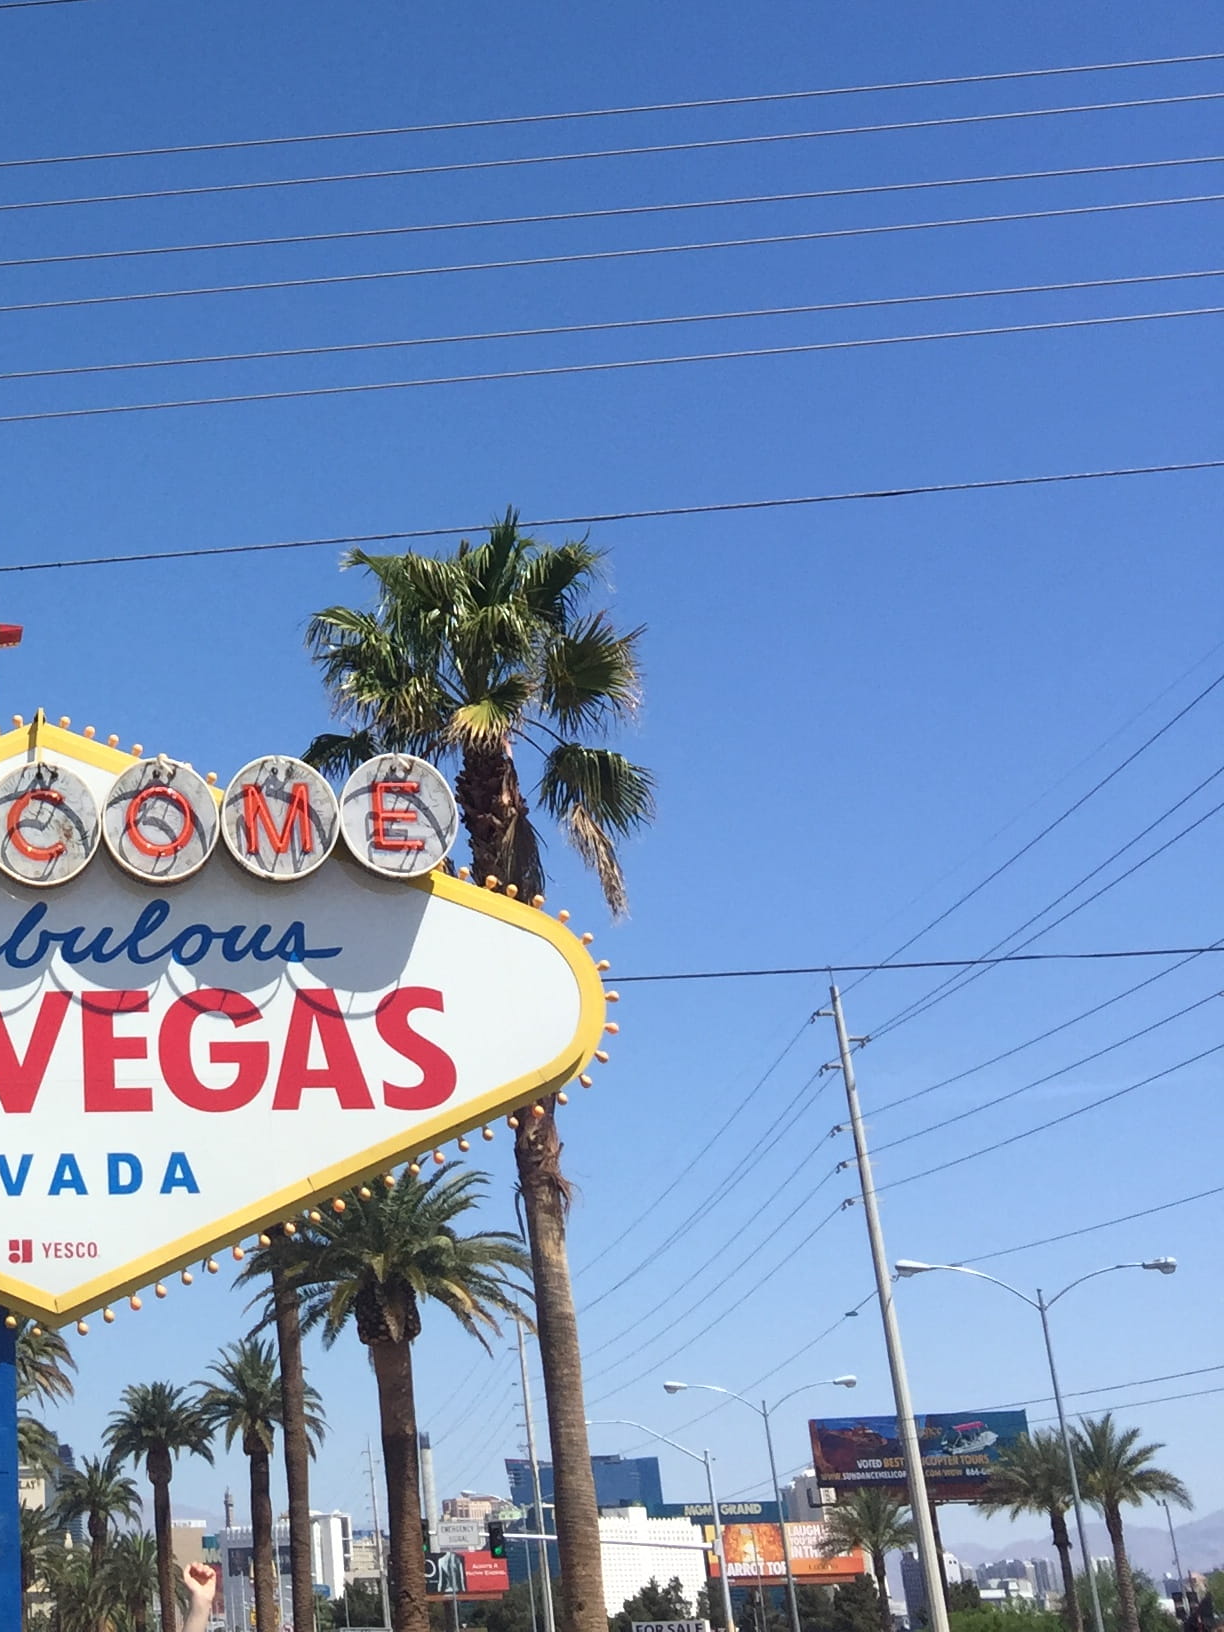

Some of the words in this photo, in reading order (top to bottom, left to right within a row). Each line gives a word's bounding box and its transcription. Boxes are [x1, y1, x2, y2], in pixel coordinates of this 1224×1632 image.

[42, 1242, 98, 1258] YESCO
[856, 1458, 882, 1469] VOTED
[882, 1457, 905, 1468] BEST
[684, 1504, 713, 1516] MGM
[720, 1503, 762, 1516] GRAND
[787, 1524, 821, 1537] LAUGH
[727, 1562, 764, 1577] ARROT
[636, 1624, 665, 1632] FOR
[669, 1623, 703, 1632] SALE
